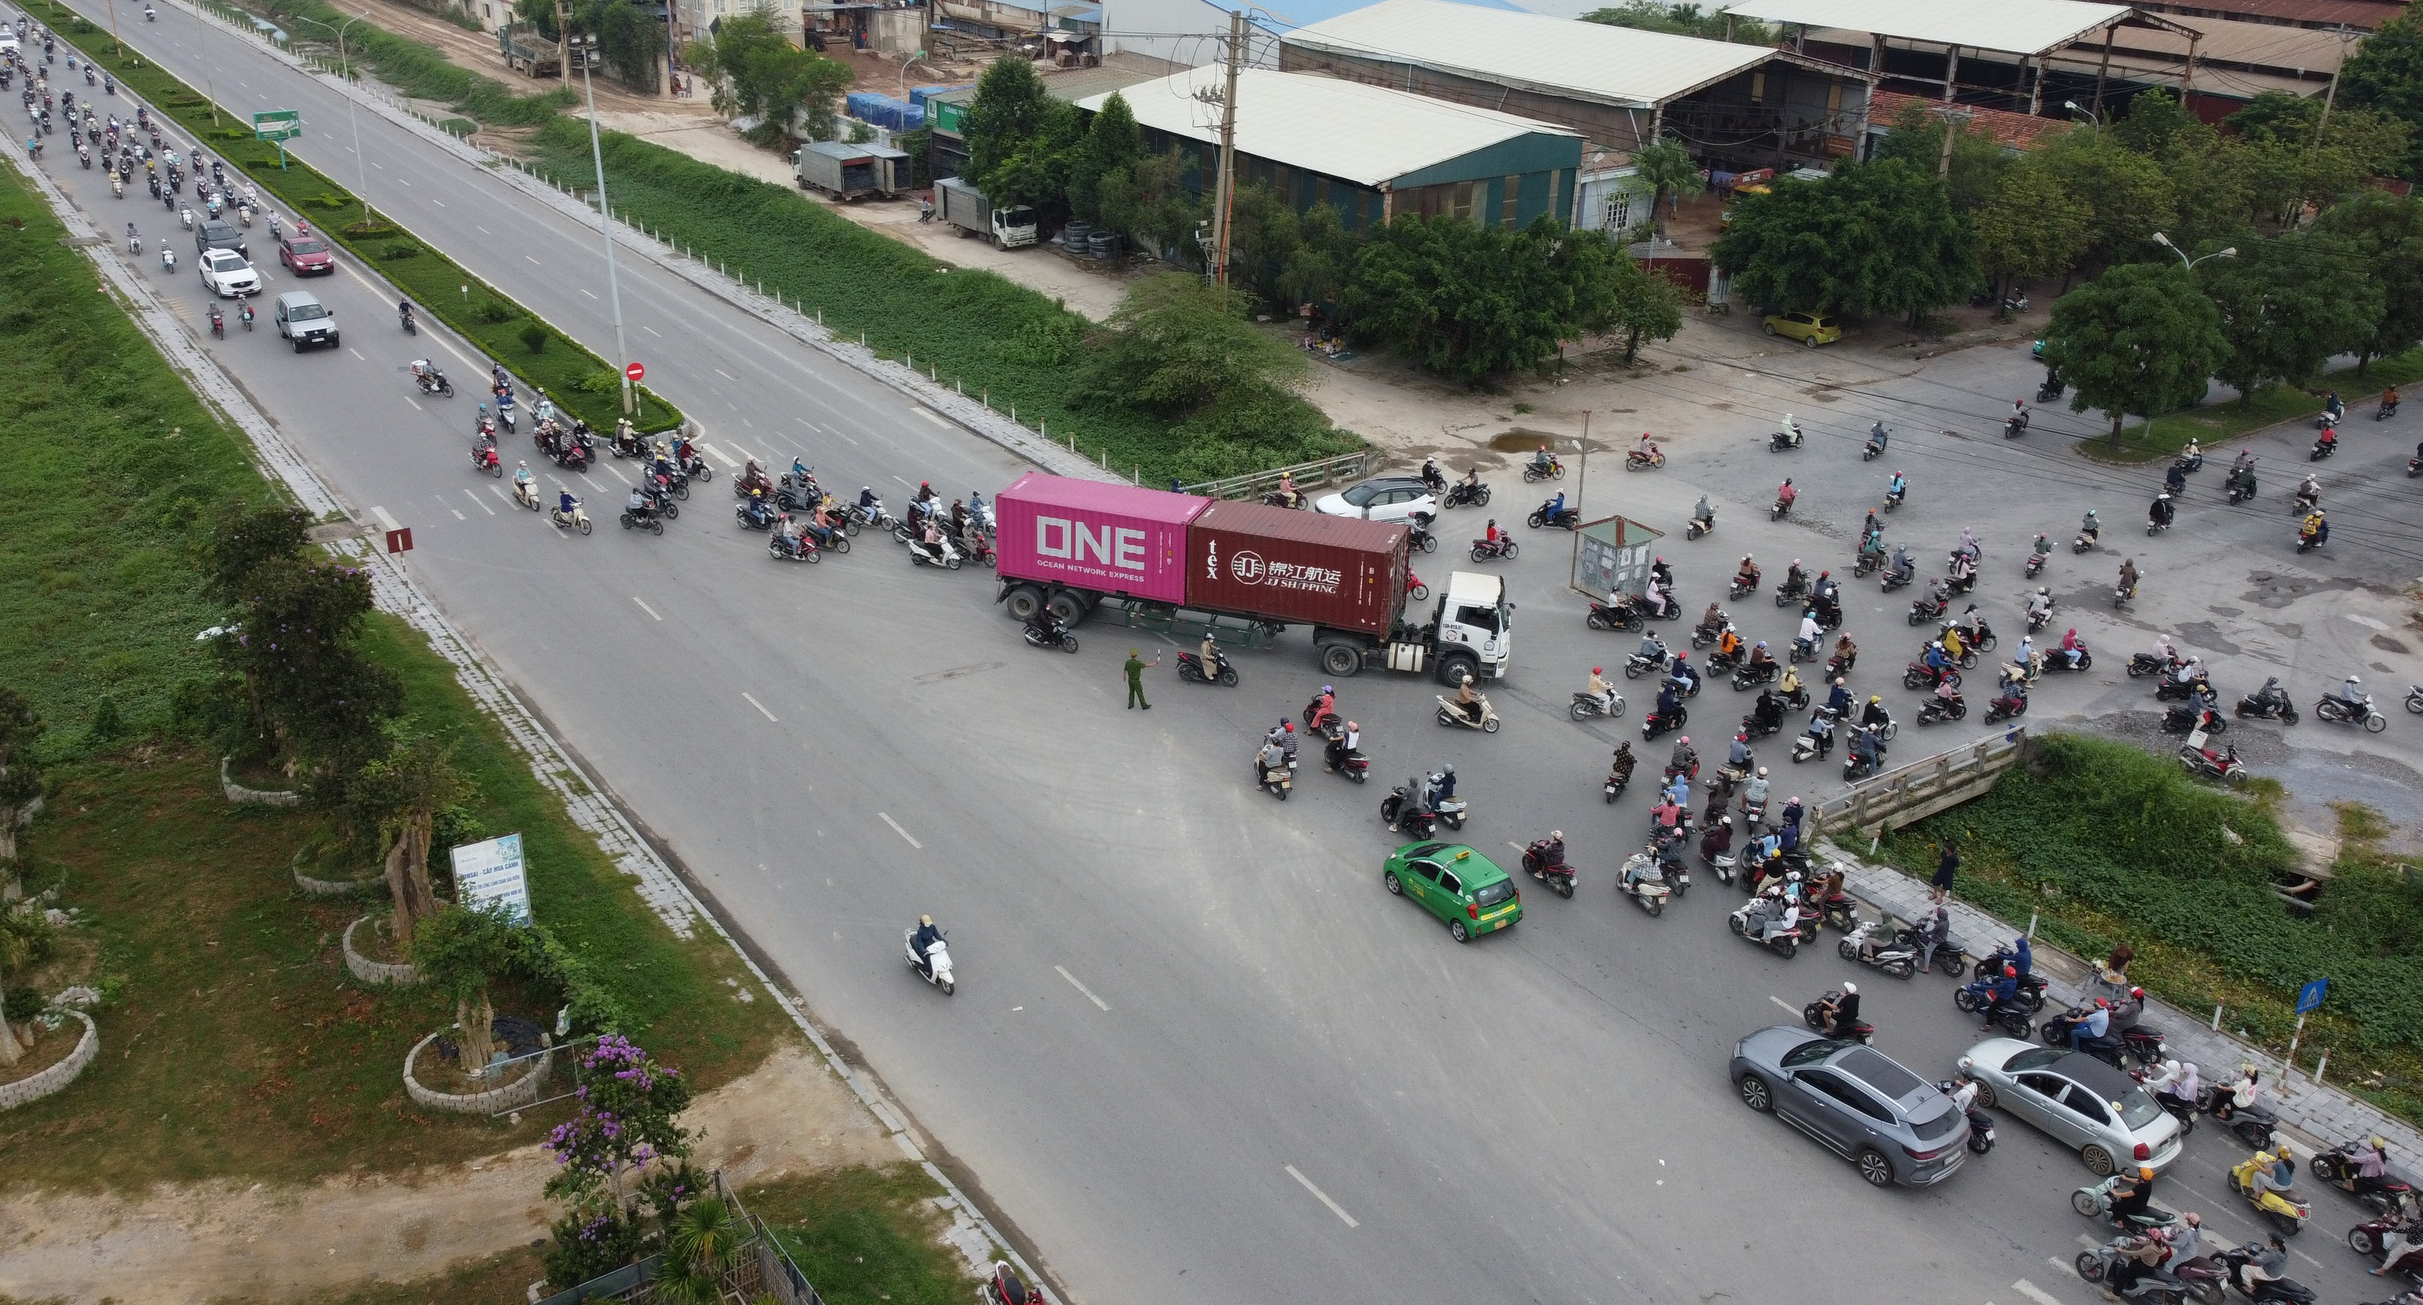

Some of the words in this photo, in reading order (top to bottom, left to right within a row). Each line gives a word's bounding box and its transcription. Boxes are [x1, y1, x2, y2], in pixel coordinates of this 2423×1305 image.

[1037, 515, 1145, 570] ONE
[1037, 559, 1064, 570] OCEAN
[1068, 564, 1106, 577] NETWORK
[1109, 571, 1144, 582] EXPRESS
[1207, 540, 1218, 579] tex
[1268, 561, 1342, 584] 锦江航运
[1265, 578, 1278, 586] JJ
[1281, 580, 1337, 594] SHIPPING
